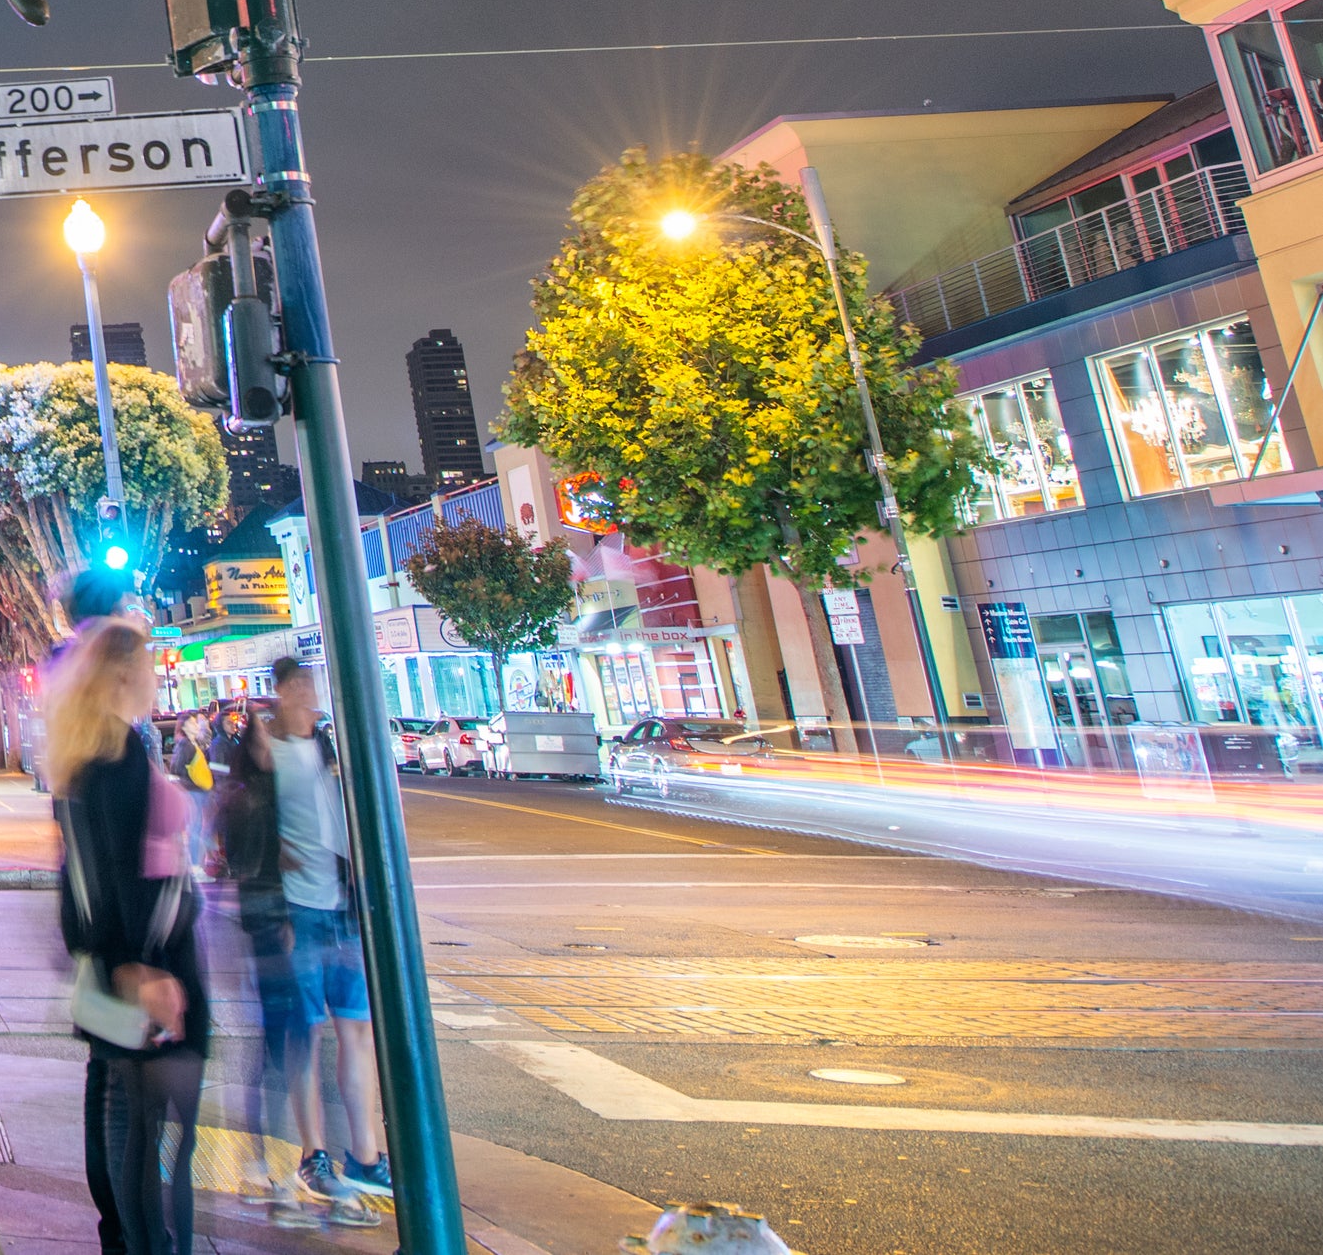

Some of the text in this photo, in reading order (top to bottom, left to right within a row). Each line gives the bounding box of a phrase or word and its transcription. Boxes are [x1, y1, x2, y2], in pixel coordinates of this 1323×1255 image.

[7, 84, 74, 114] 200
[635, 630, 658, 642] the
[661, 628, 689, 641] box
